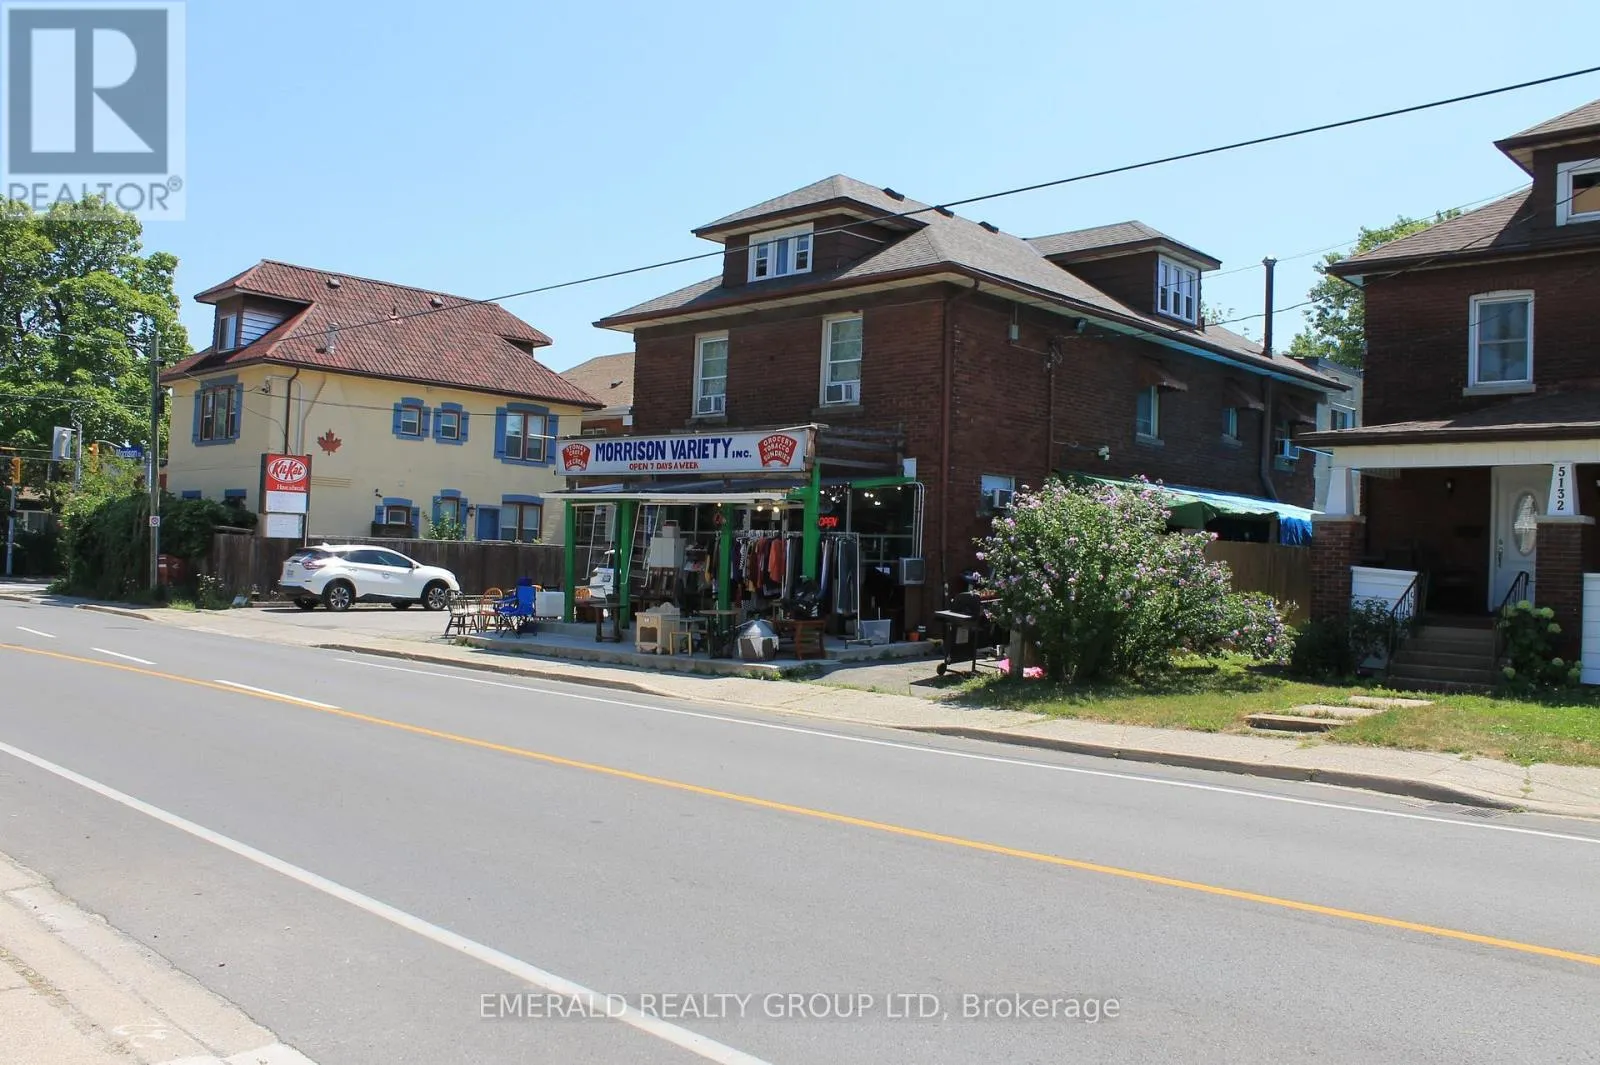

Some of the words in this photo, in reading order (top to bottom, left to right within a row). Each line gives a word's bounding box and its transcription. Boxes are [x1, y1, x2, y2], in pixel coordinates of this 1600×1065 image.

[763, 435, 794, 447] GROCERY
[115, 448, 138, 457] Morrison
[595, 440, 667, 462] MORRISON
[670, 437, 733, 460] VARIETY
[732, 450, 752, 458] INC.
[763, 442, 790, 454] TOBACCO
[763, 450, 791, 463] SUNDRIES
[629, 463, 649, 471] OPEN
[650, 462, 655, 470] 7
[656, 462, 673, 470] DAYS
[678, 462, 699, 470] WEEK
[1557, 466, 1566, 511] 5132
[818, 516, 839, 528] OPEN
